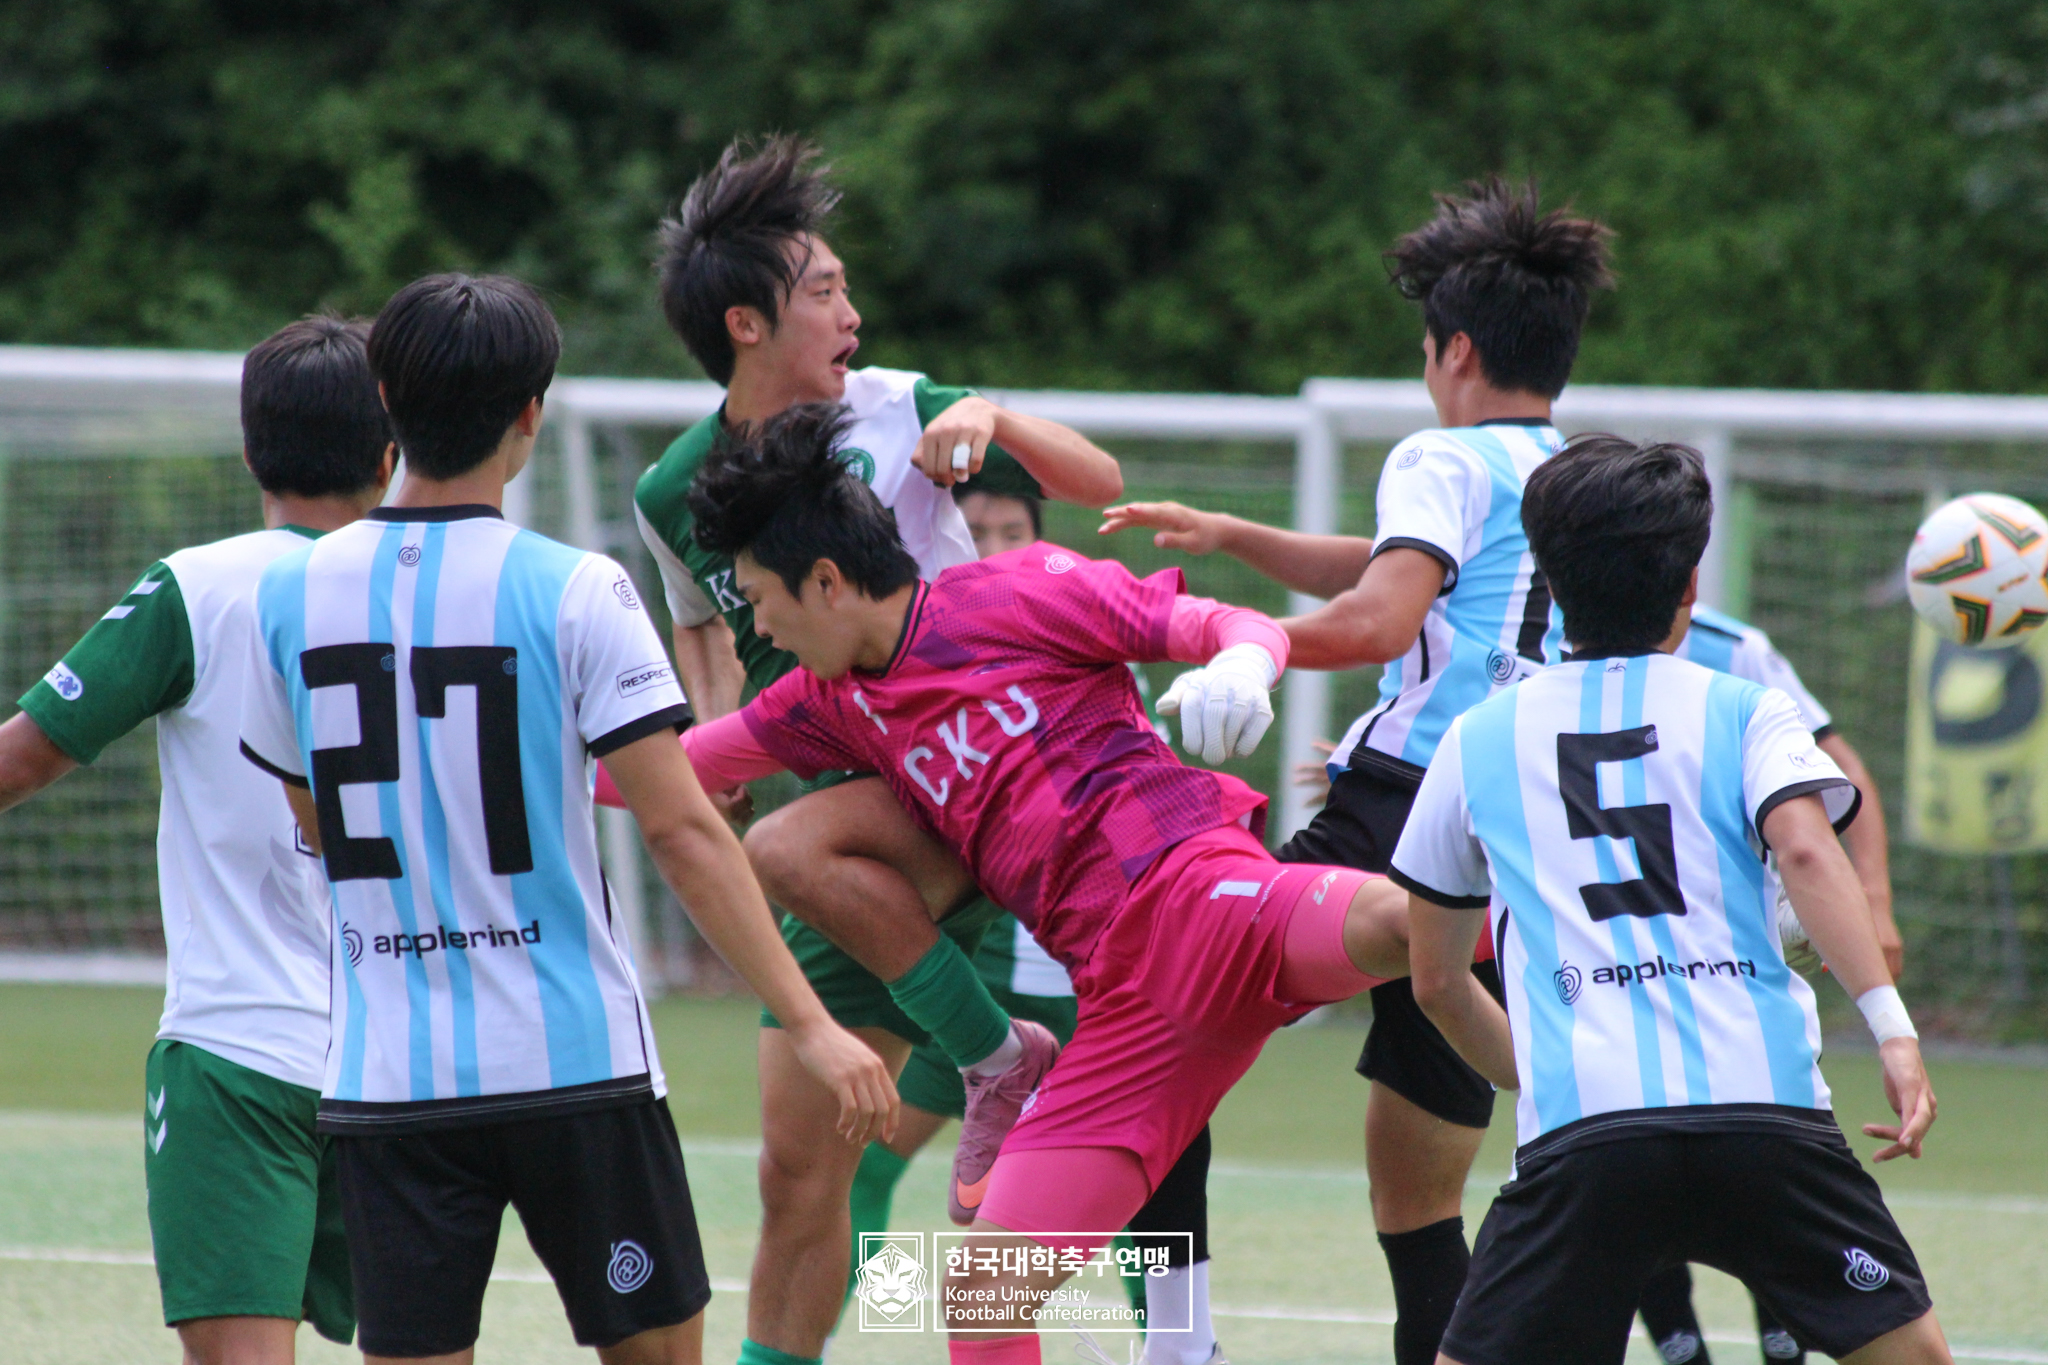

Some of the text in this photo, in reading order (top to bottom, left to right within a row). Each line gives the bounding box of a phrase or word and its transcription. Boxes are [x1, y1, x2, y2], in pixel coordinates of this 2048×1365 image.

[620, 667, 673, 690] RESPECT
[300, 642, 534, 883] 27
[904, 685, 1039, 807] CKU
[1557, 723, 1688, 923] 5
[373, 920, 541, 960] applerind
[1592, 955, 1757, 988] applerind
